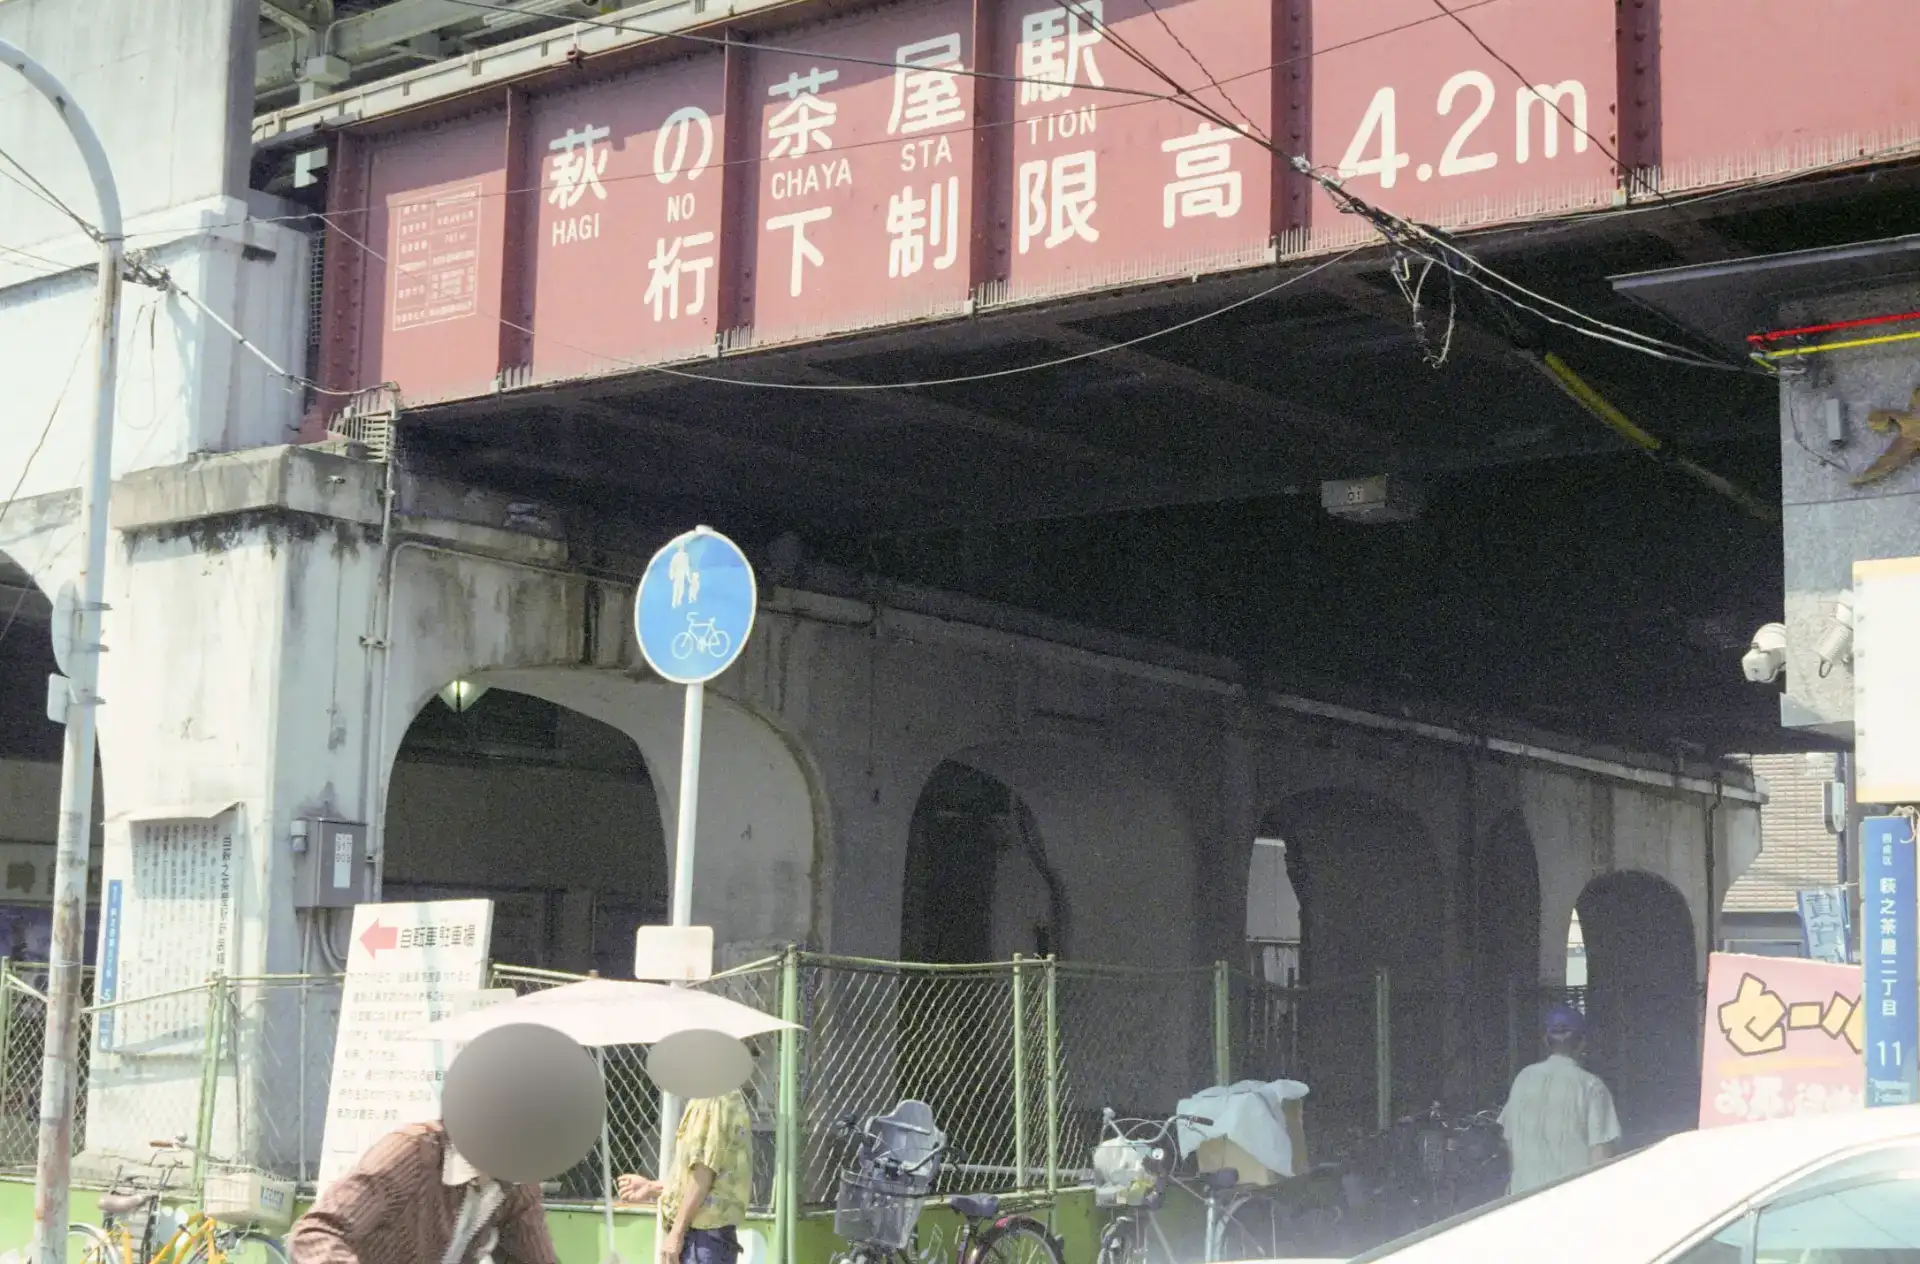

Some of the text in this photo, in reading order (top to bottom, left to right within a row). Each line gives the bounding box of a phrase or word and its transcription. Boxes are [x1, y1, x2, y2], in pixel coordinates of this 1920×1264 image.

[552, 105, 1097, 246] HAGI NO CHAYA STA TION
[643, 123, 1250, 322] 桁下制限高
[1337, 70, 1588, 190] 4.2m
[1875, 1039, 1902, 1067] 11
